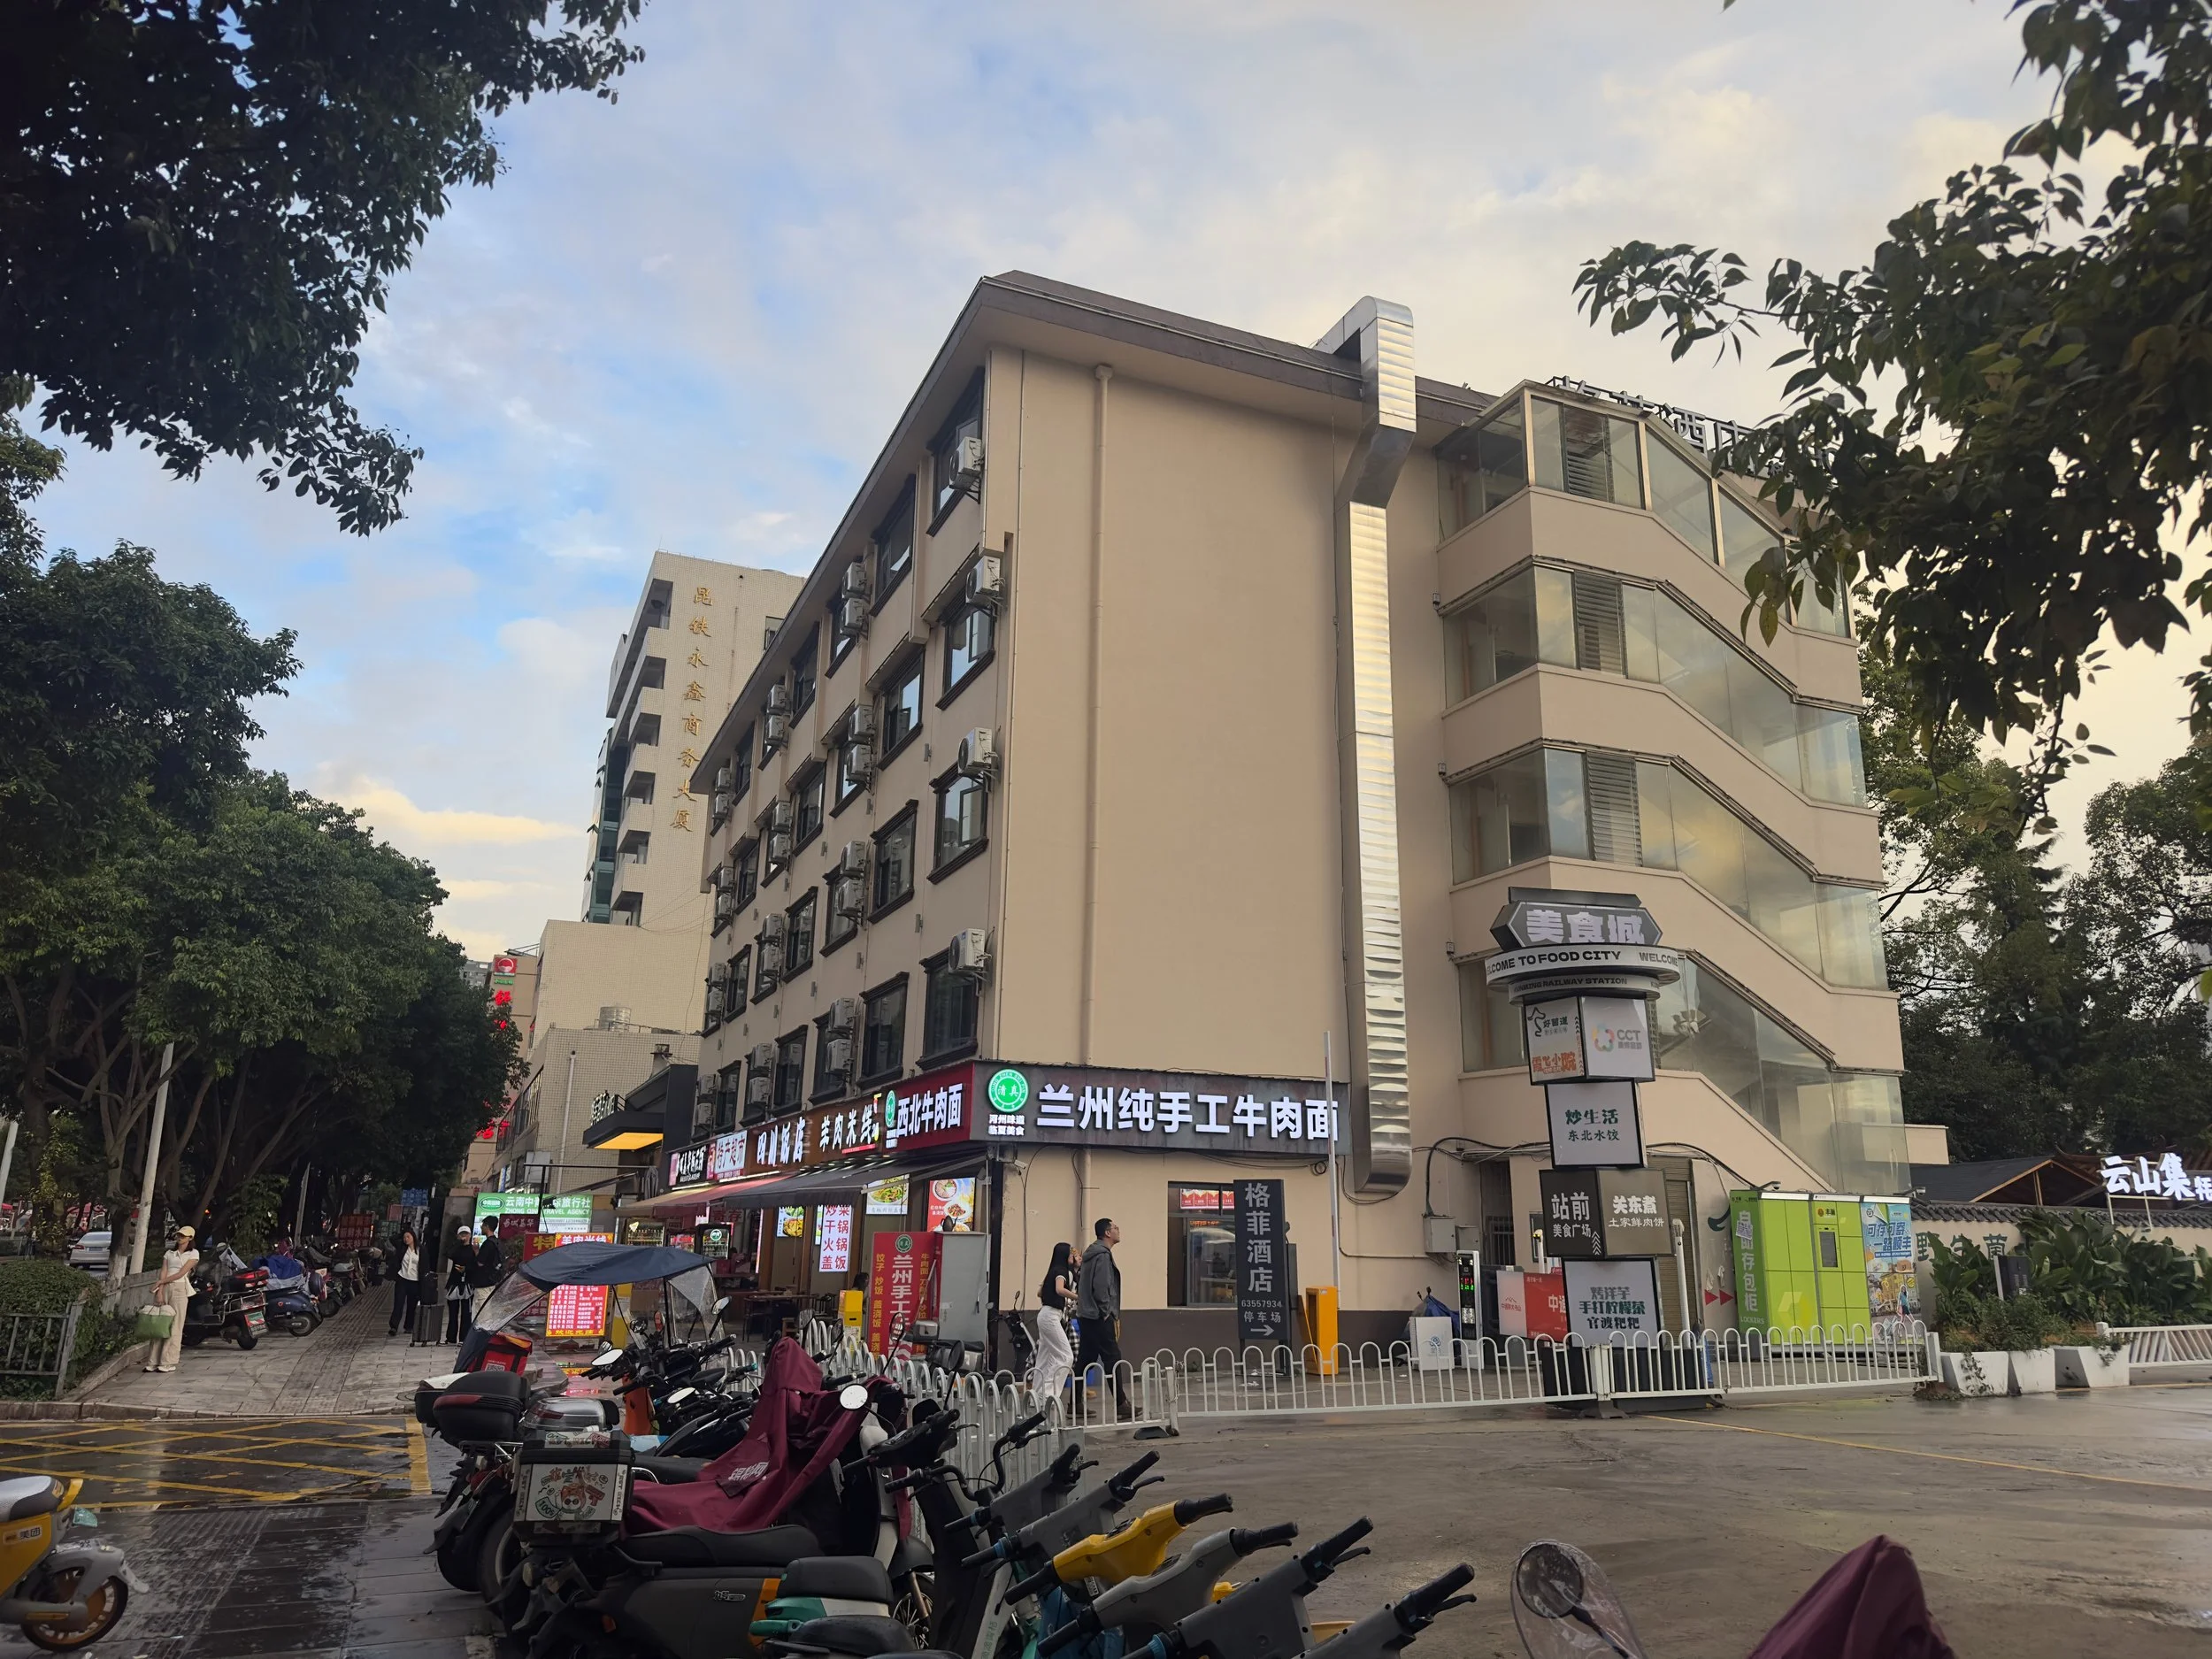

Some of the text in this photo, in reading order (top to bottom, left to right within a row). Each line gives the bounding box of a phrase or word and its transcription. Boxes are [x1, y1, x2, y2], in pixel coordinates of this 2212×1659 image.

[1525, 909, 1645, 944] 美食城
[1518, 955, 1537, 966] TO
[1538, 951, 1580, 964] FOOD
[1582, 950, 1621, 961] CITY
[1542, 978, 1584, 987] RAILWAY
[1617, 1029, 1640, 1041] CCT
[998, 1084, 1019, 1097] 清真
[897, 1083, 963, 1139] 西北牛肉面
[1037, 1084, 1339, 1141] 兰州纯手工牛肉面
[1564, 1109, 1619, 1125] 炒生活
[819, 1104, 873, 1152] 羊肉米线
[1568, 1129, 1620, 1141] 东北水饺
[757, 1116, 806, 1168] 四川饭店
[717, 1134, 745, 1170] 特产超市
[2101, 1153, 2195, 1201] 云山集
[826, 1205, 849, 1217] 炒菜
[1551, 1191, 1590, 1221] 站前
[1613, 1194, 1657, 1215] 关东煮
[824, 1219, 849, 1234] 干锅
[1608, 1217, 1664, 1228] 土家鲜肉饼
[1245, 1182, 1273, 1293] 格菲酒店
[1553, 1223, 1592, 1238] 美食广场
[823, 1237, 849, 1252] 火锅
[1873, 1236, 1911, 1252] 一路顺丰
[821, 1255, 846, 1271] 盖饭
[1241, 1299, 1283, 1309] 63557934
[1578, 1301, 1645, 1315] 手打柠檬茶
[1243, 1310, 1281, 1323] 停车场
[1586, 1316, 1640, 1329] 官渡粑粑
[1740, 1316, 1764, 1325] LOCKERS
[19, 1527, 41, 1540] 美团
